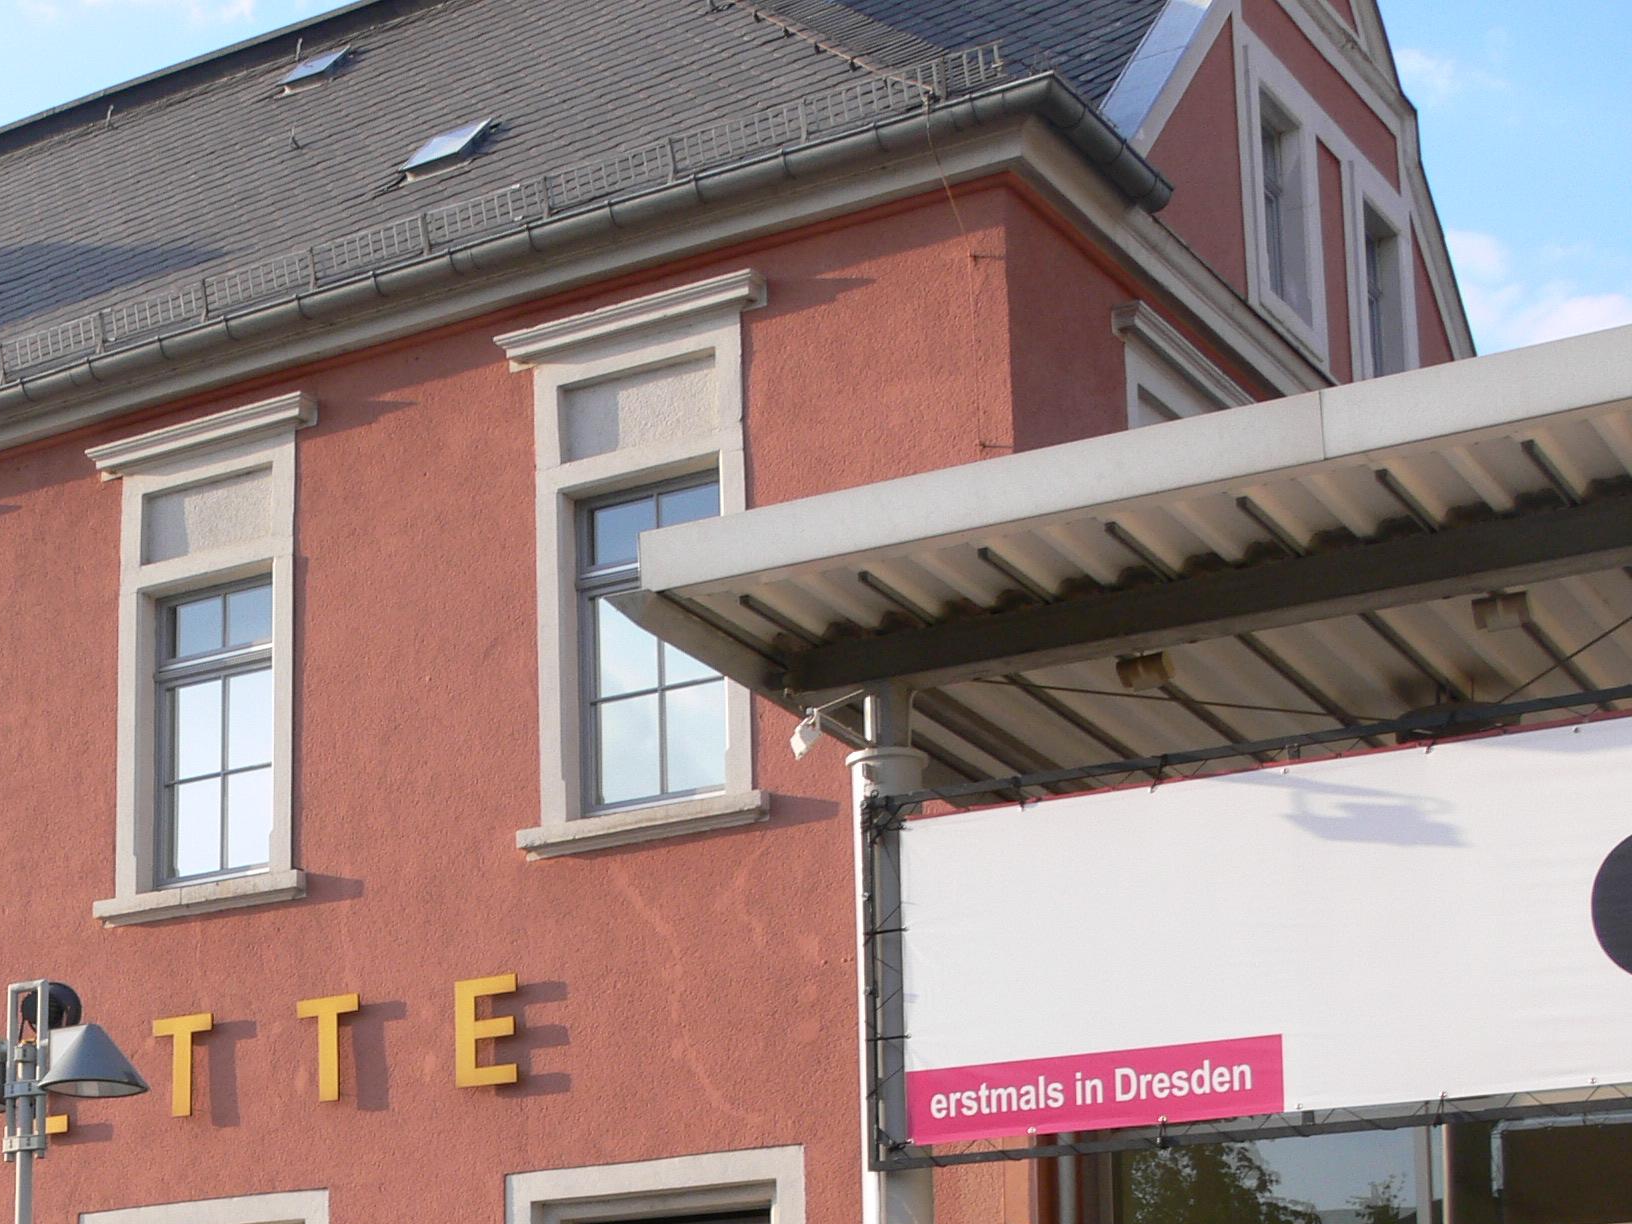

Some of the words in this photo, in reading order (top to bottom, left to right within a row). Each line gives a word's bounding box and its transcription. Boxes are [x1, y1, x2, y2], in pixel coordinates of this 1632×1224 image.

[929, 1075, 1065, 1120] erstmals
[1075, 1071, 1104, 1106] in
[1114, 1059, 1253, 1103] Dresden
